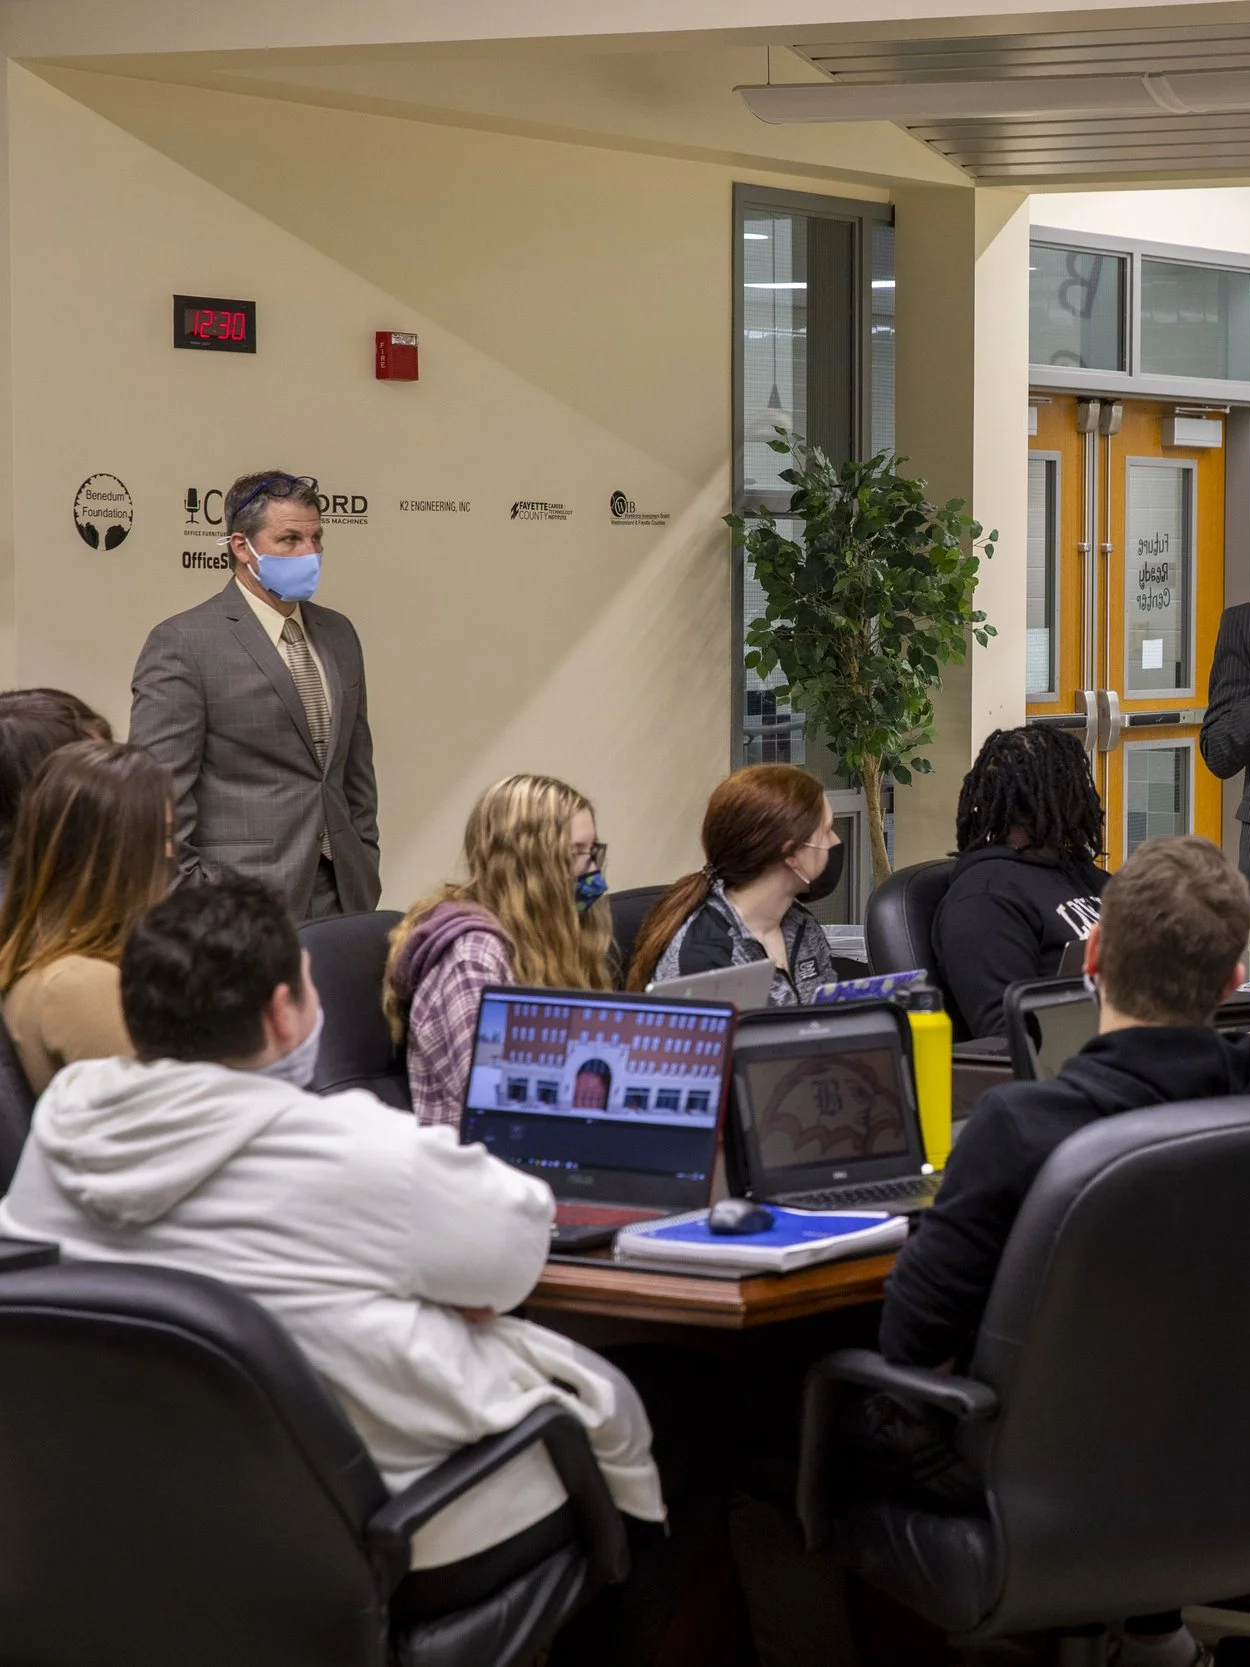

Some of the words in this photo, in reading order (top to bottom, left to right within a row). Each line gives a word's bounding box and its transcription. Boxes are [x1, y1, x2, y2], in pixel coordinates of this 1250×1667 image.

[193, 309, 246, 341] 12:30
[86, 490, 125, 502] Benedum
[400, 501, 409, 511] K2
[411, 501, 458, 513] ENGINEERING,
[459, 502, 471, 512] INC
[519, 501, 548, 511] FAYETTE
[82, 507, 128, 519] Foundation
[519, 511, 548, 520] COUNTY
